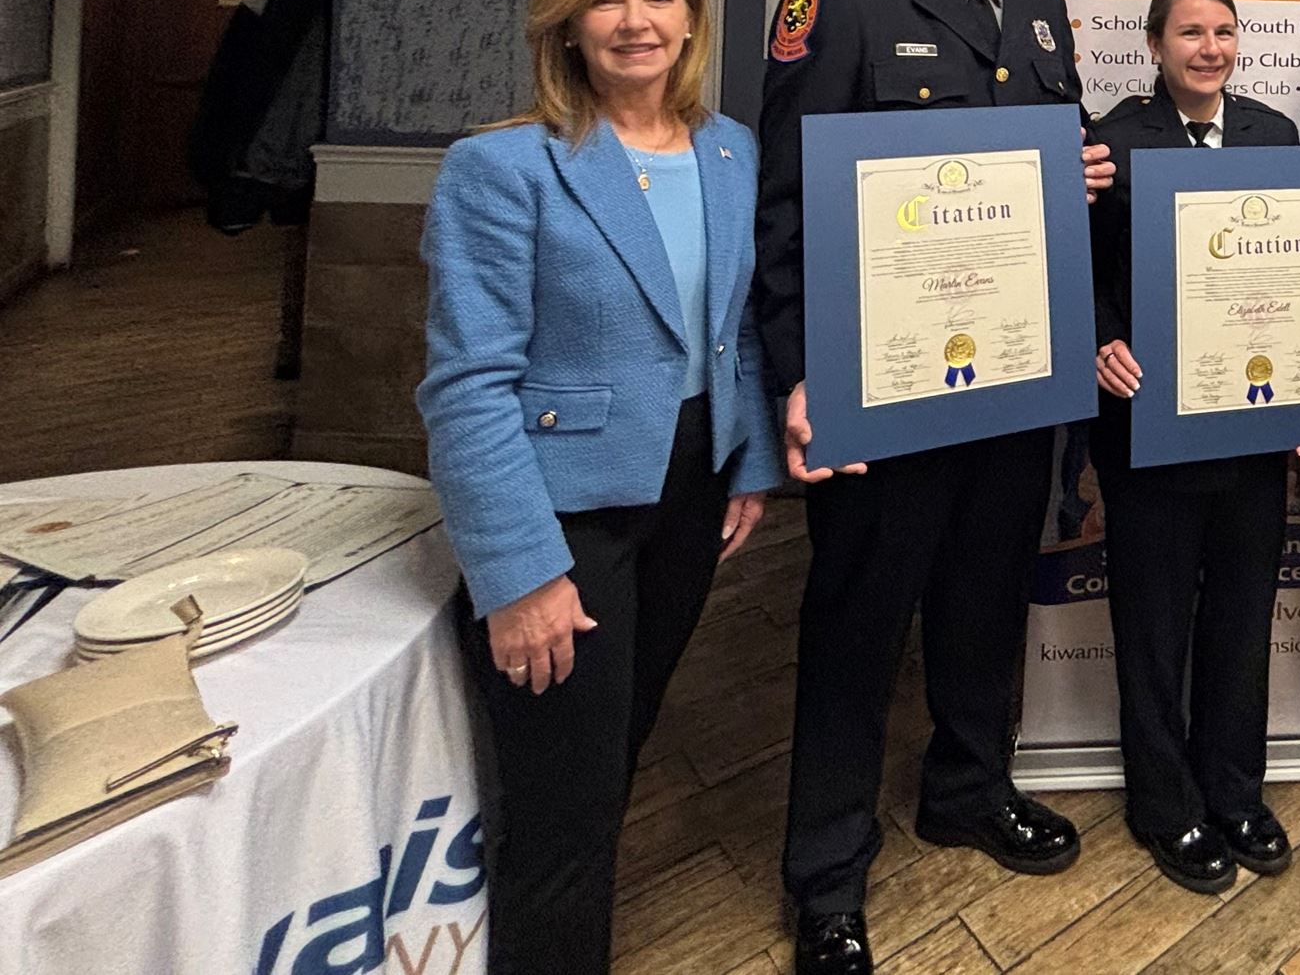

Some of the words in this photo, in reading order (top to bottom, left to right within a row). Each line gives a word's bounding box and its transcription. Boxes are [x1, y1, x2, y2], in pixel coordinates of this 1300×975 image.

[1239, 18, 1295, 35] Youth
[906, 46, 929, 54] EVANS
[1091, 49, 1145, 65] Youth
[1086, 77, 1123, 96] (Key
[1252, 81, 1291, 96] Club
[895, 194, 1012, 233] Citation
[1066, 574, 1108, 595] Co
[1041, 643, 1115, 662] kiwanis
